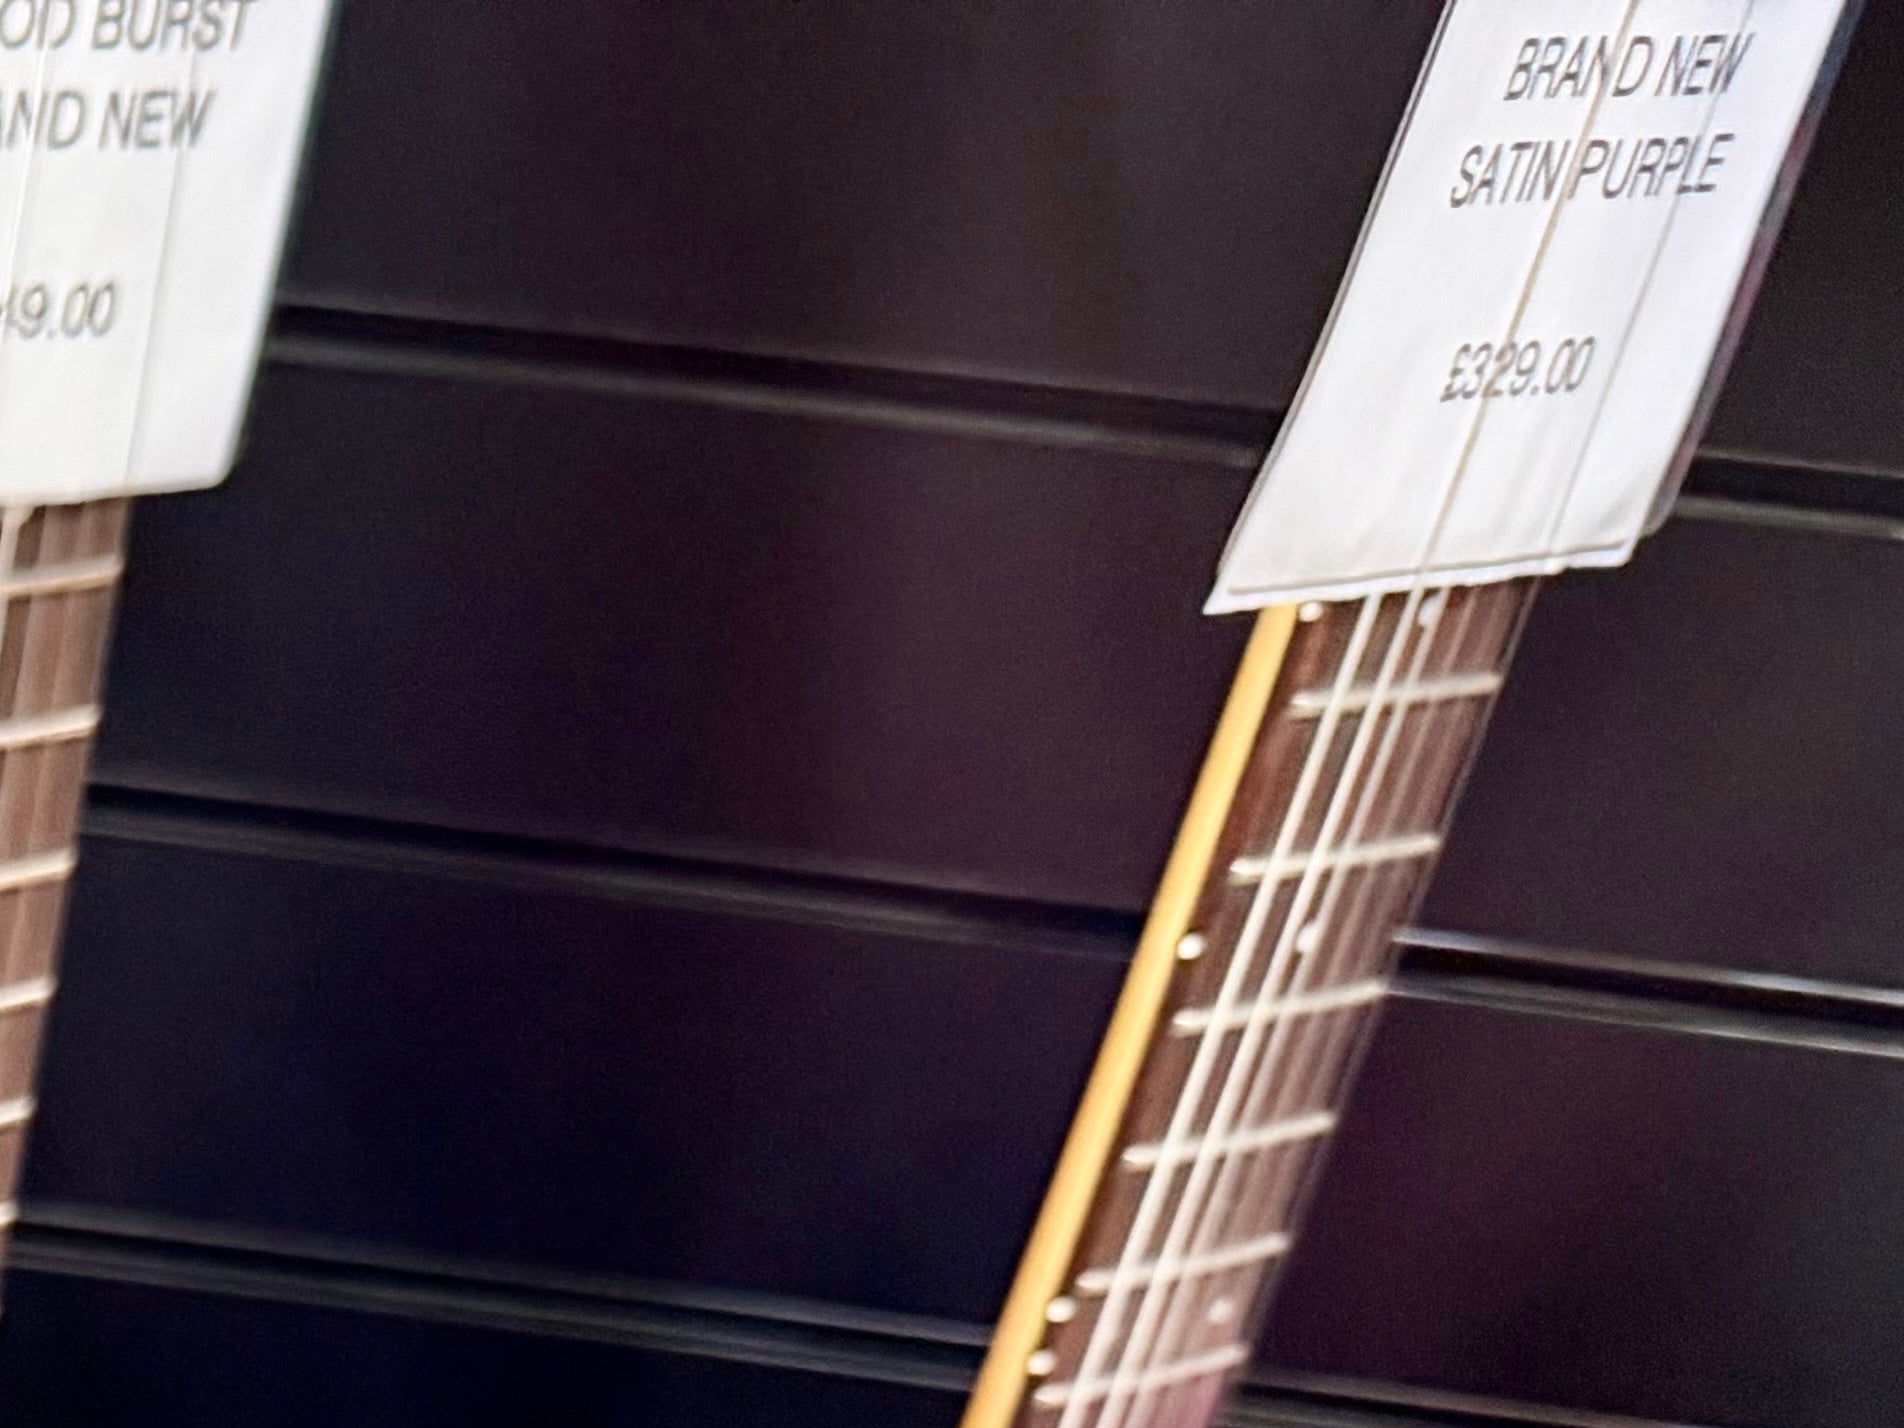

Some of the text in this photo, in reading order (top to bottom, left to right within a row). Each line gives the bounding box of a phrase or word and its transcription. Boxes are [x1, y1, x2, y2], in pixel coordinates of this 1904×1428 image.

[90, 0, 255, 53] BURST
[1502, 33, 1754, 102] BRAND NEW
[98, 89, 216, 151] NEW
[1449, 133, 1734, 207] SATIN PURPLE
[1439, 336, 1596, 403] £329.00
